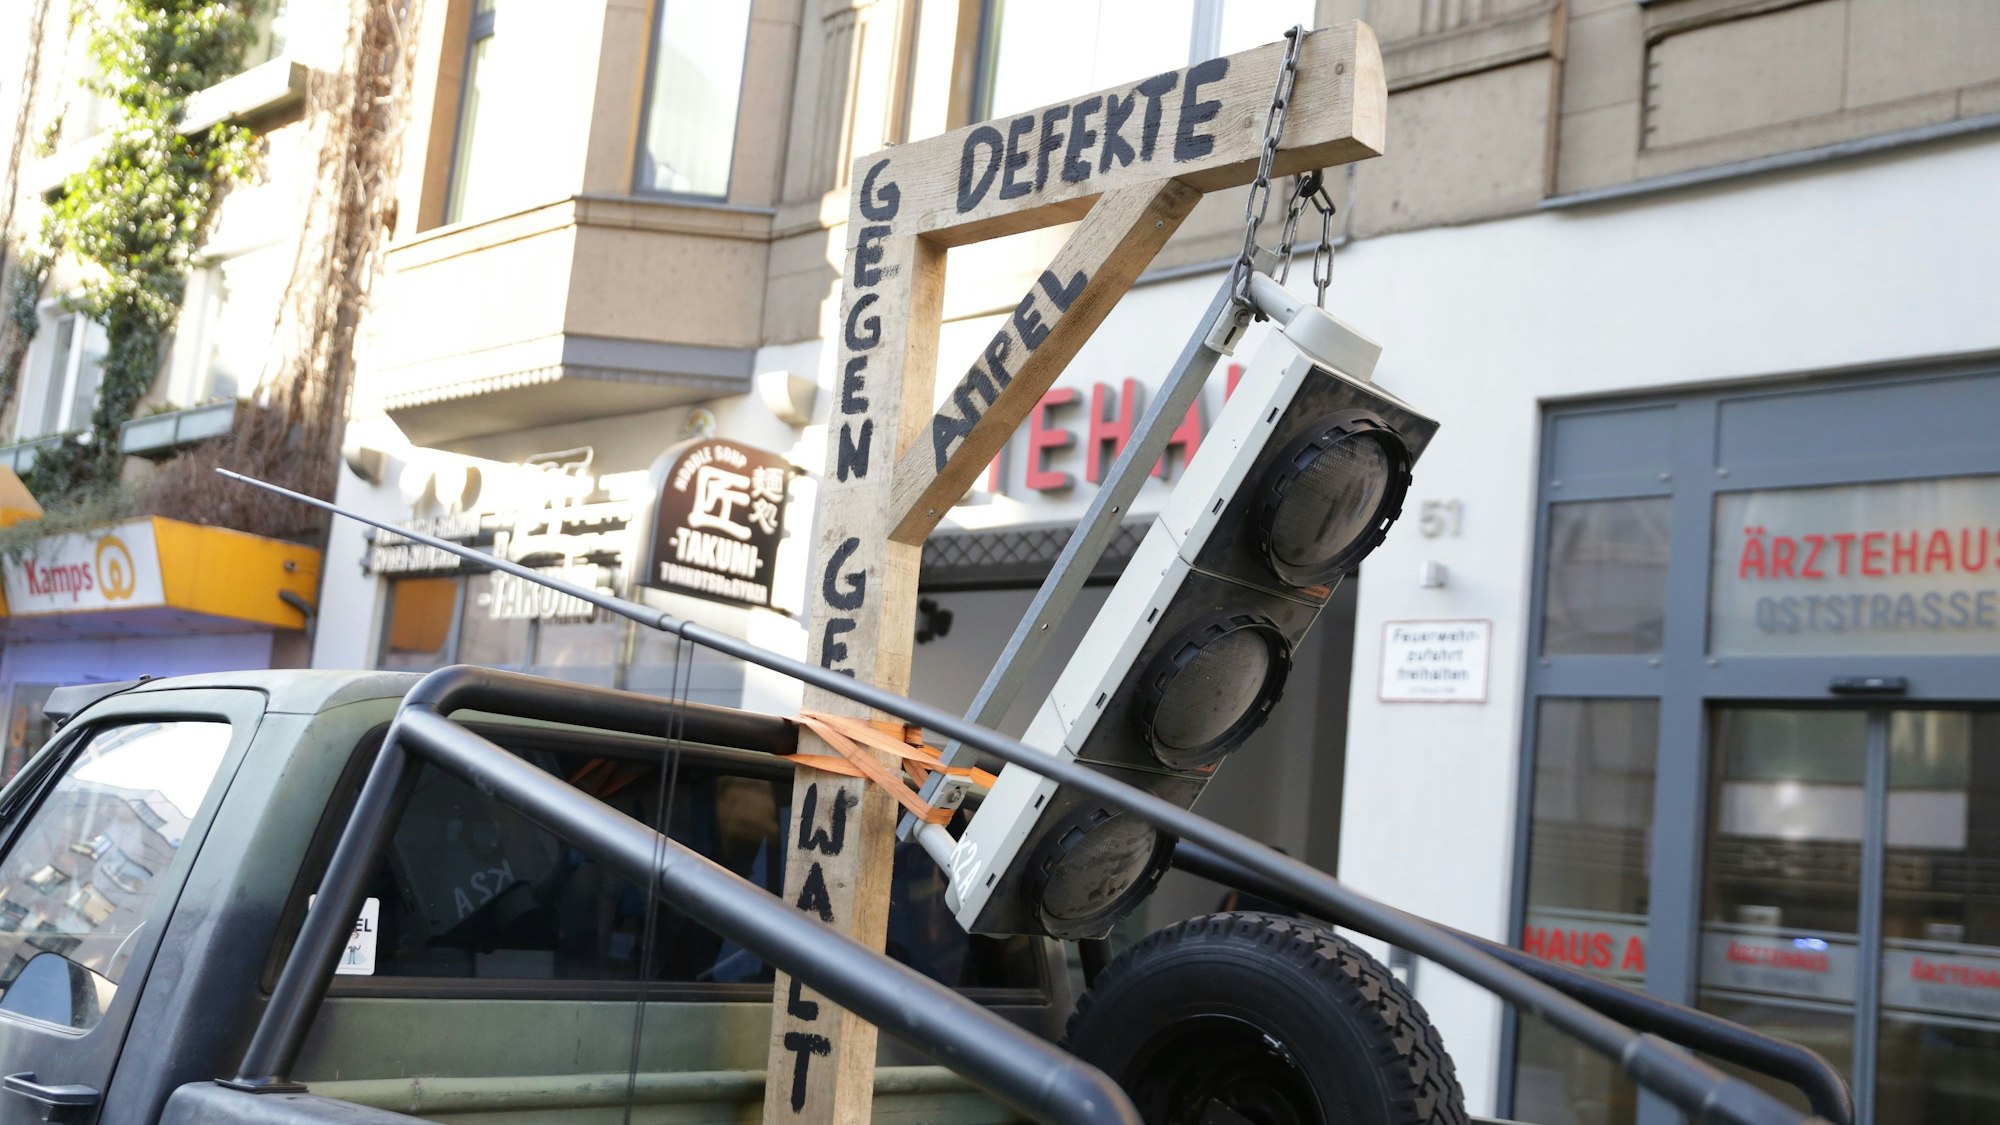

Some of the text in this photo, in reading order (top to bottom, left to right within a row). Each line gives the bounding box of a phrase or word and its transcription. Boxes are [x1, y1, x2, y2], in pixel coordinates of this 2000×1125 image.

[956, 58, 1230, 214] DEFEKTE
[836, 158, 901, 483] GEGEN
[932, 269, 1089, 475] AMPEL
[687, 465, 752, 540] 匠
[1419, 499, 1464, 539] 51
[1738, 526, 2000, 580] ÄRZTEHAU
[23, 559, 94, 602] Kamps
[1755, 590, 1996, 633] OSTSTRASSE
[1523, 925, 1613, 968] HAUS
